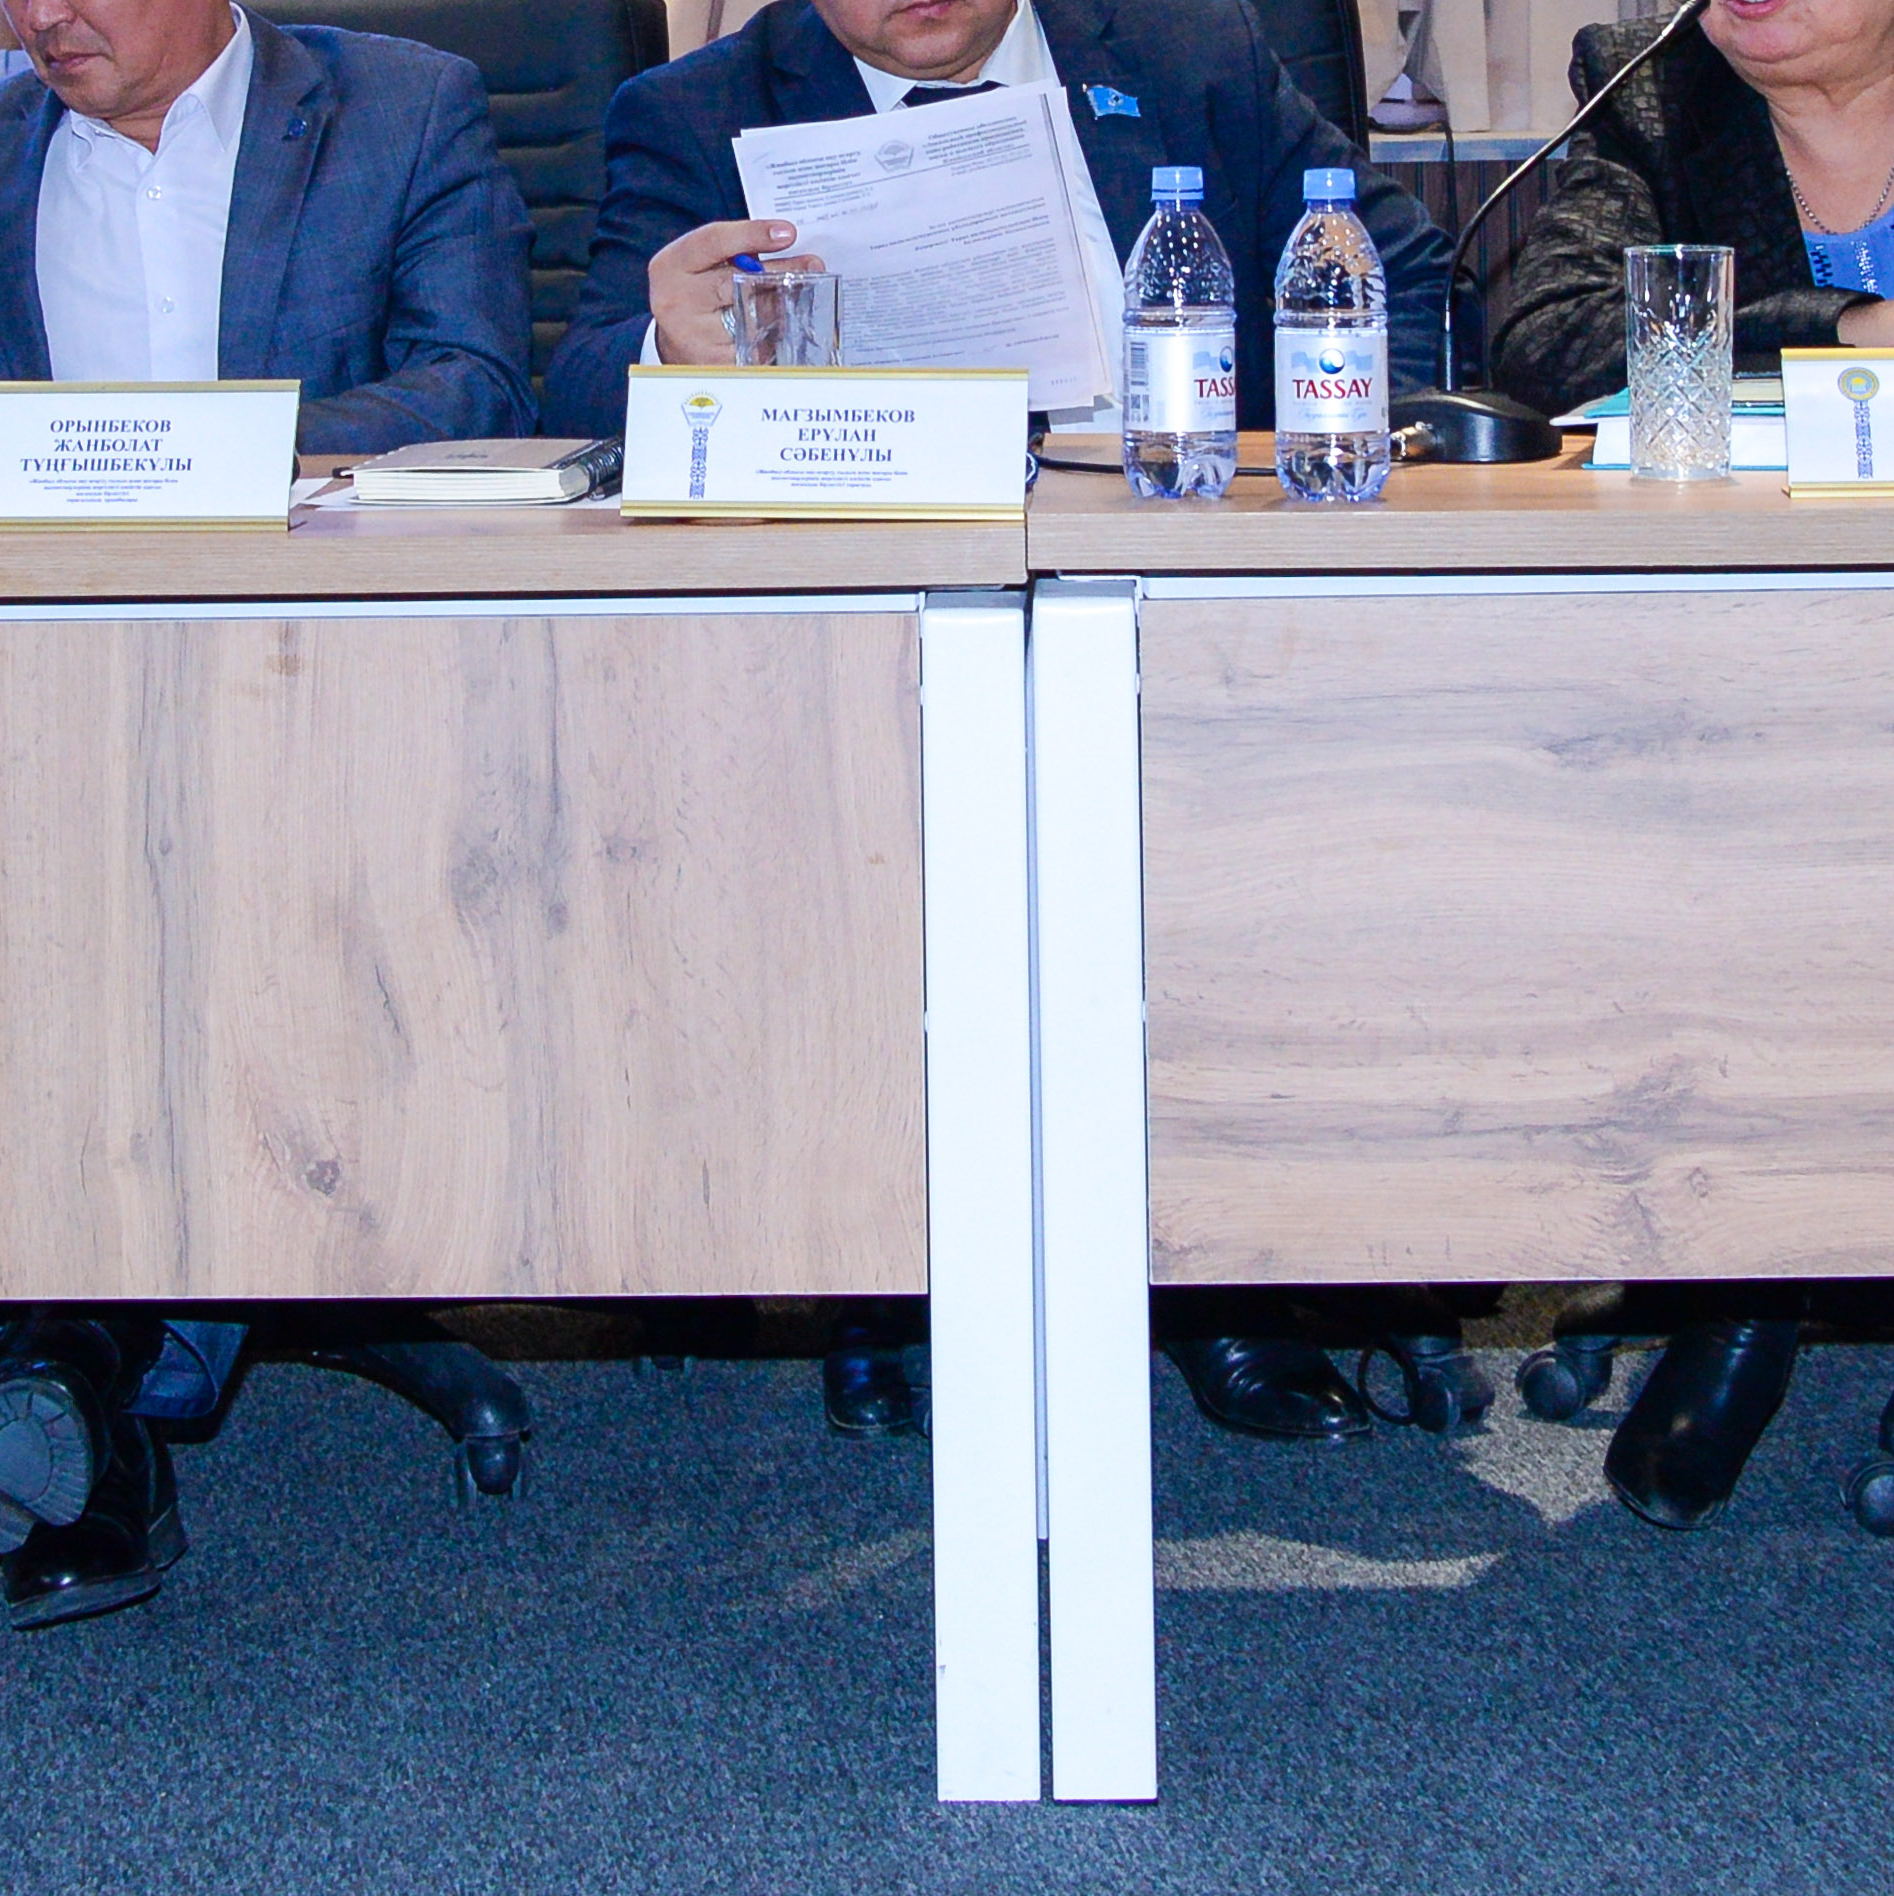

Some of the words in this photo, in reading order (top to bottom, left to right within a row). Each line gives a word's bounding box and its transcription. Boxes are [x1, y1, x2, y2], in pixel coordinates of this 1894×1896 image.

[1292, 378, 1373, 400] TASSAY
[49, 419, 171, 433] ОРЫНБЕКОВ
[54, 438, 163, 452] ЖАНБОЛАТ
